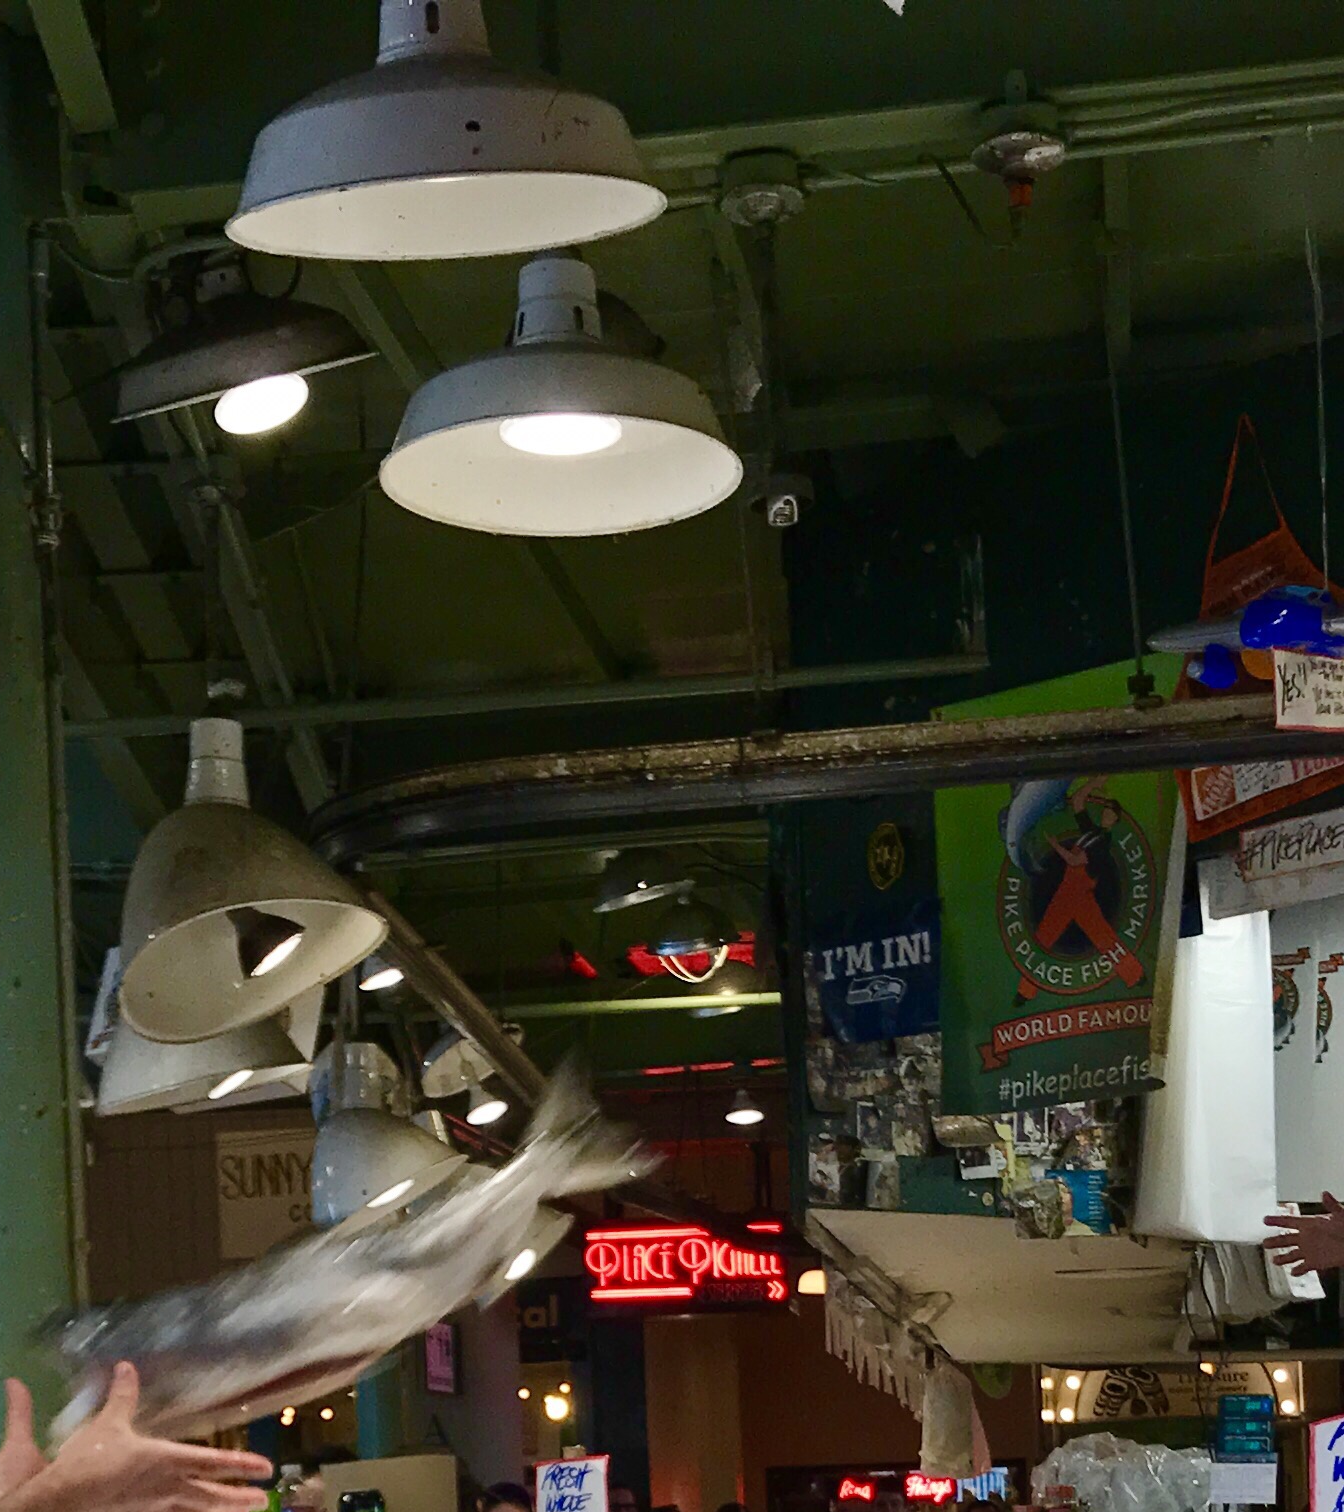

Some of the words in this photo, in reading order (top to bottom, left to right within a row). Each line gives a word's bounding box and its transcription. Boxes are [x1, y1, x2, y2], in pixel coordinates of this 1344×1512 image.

[1004, 877, 1022, 935] PIKE
[1015, 940, 1072, 987] PLACE
[1080, 942, 1127, 984] FISH
[1123, 832, 1149, 940] MARKET
[822, 941, 874, 981] I'M
[881, 931, 932, 970] IN!
[996, 1014, 1071, 1046] WORLD
[1078, 1004, 1151, 1035] FAMOU
[221, 1151, 312, 1201] SUNNY
[541, 1462, 594, 1492] FRESH
